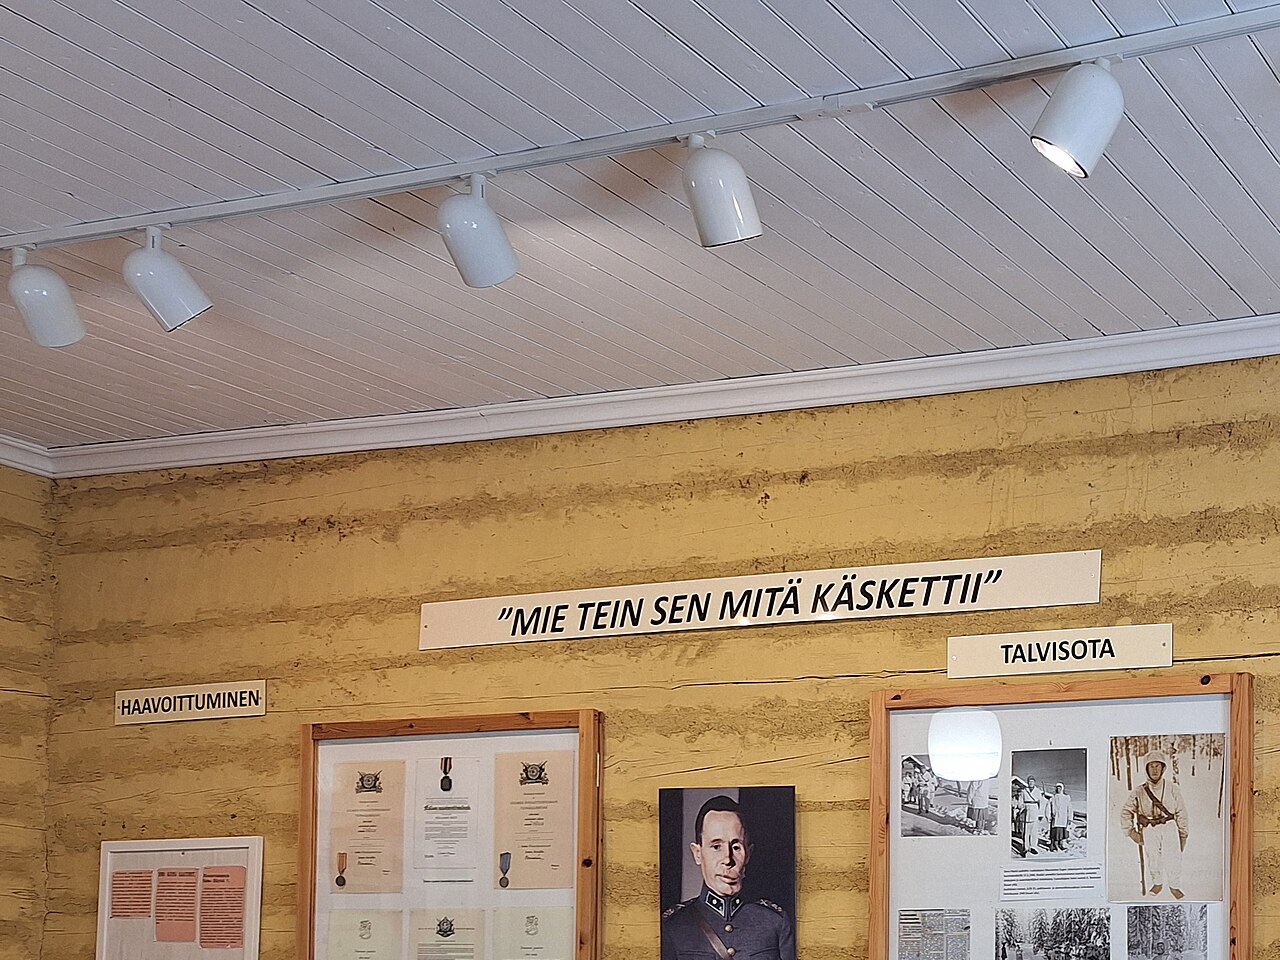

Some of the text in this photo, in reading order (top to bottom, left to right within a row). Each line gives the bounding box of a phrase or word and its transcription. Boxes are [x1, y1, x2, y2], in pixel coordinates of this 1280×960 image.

[498, 569, 1002, 636] ”MIE TEIN SEN MITÄ KÄSKETTII”
[1001, 639, 1115, 663] TALVISOTA
[121, 690, 260, 715] HAAVOITTUMINEN
